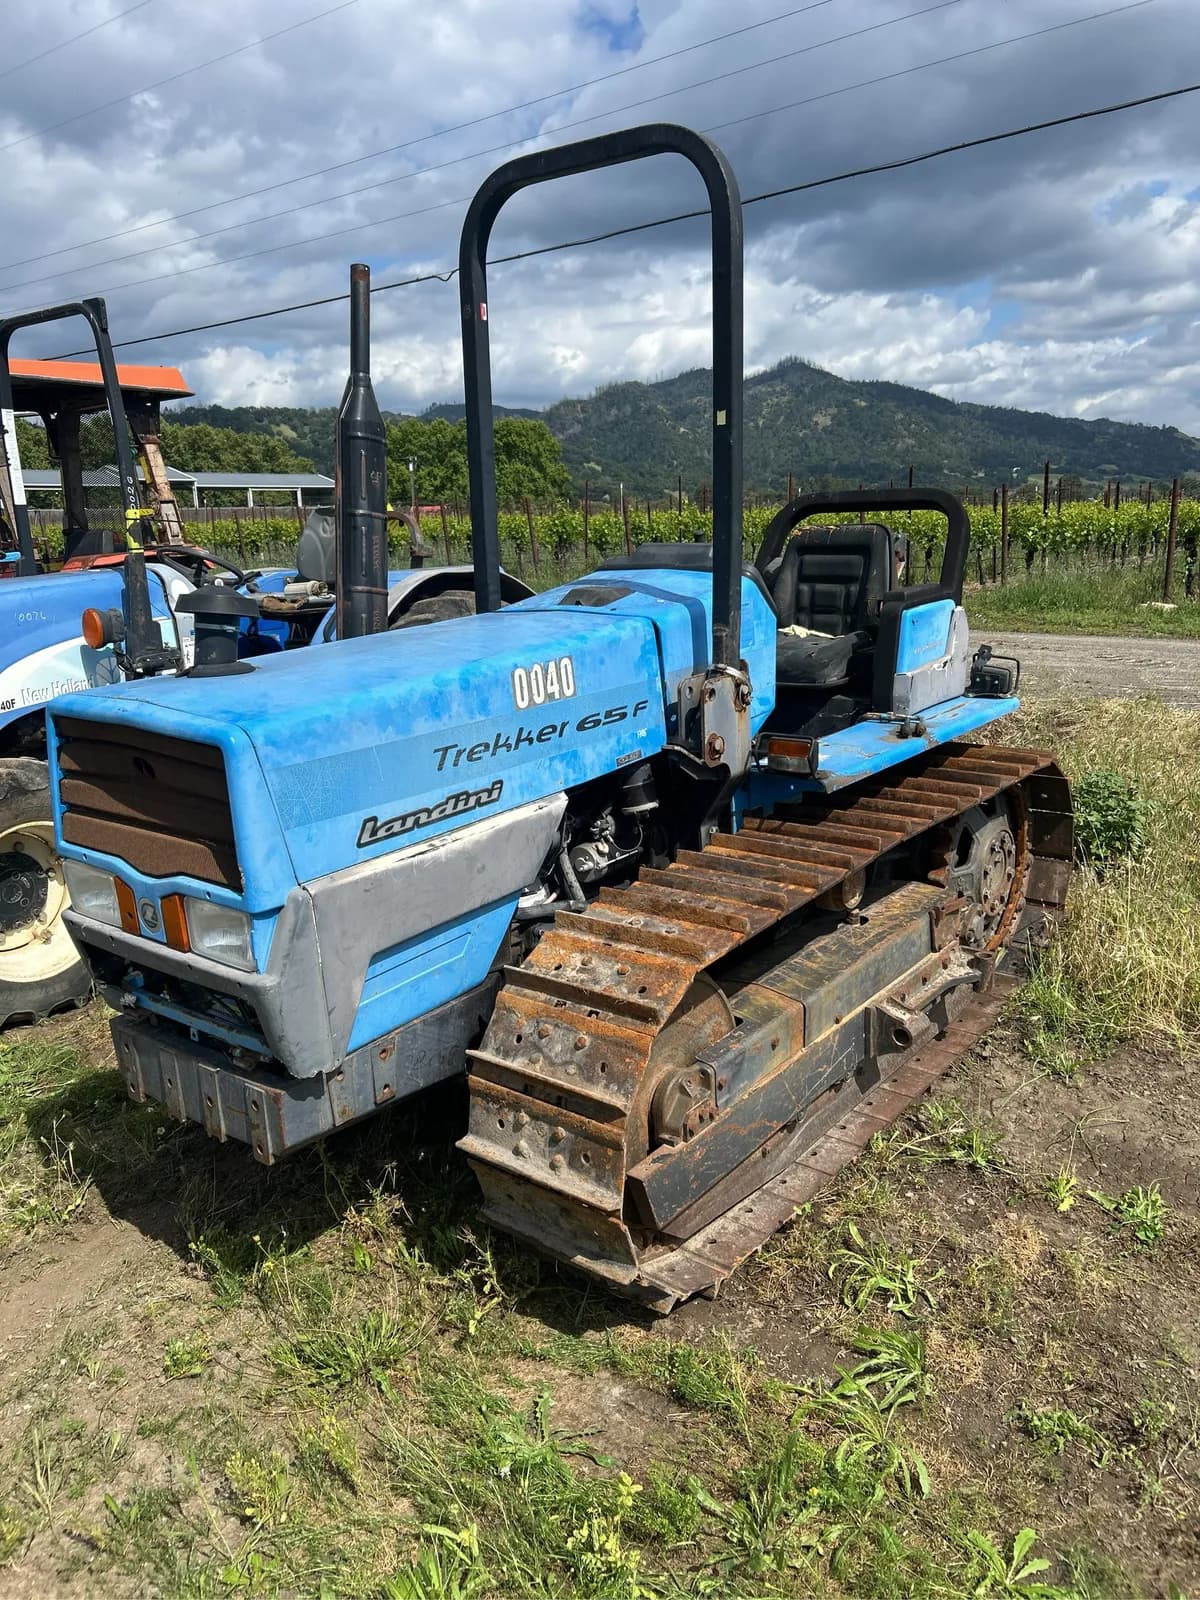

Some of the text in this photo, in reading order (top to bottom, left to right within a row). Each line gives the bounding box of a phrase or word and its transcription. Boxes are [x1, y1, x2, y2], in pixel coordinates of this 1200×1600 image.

[21, 675, 95, 706] New Holland
[512, 657, 575, 709] 0040
[433, 699, 649, 772] Trekker 65 F
[356, 780, 503, 848] Landini
